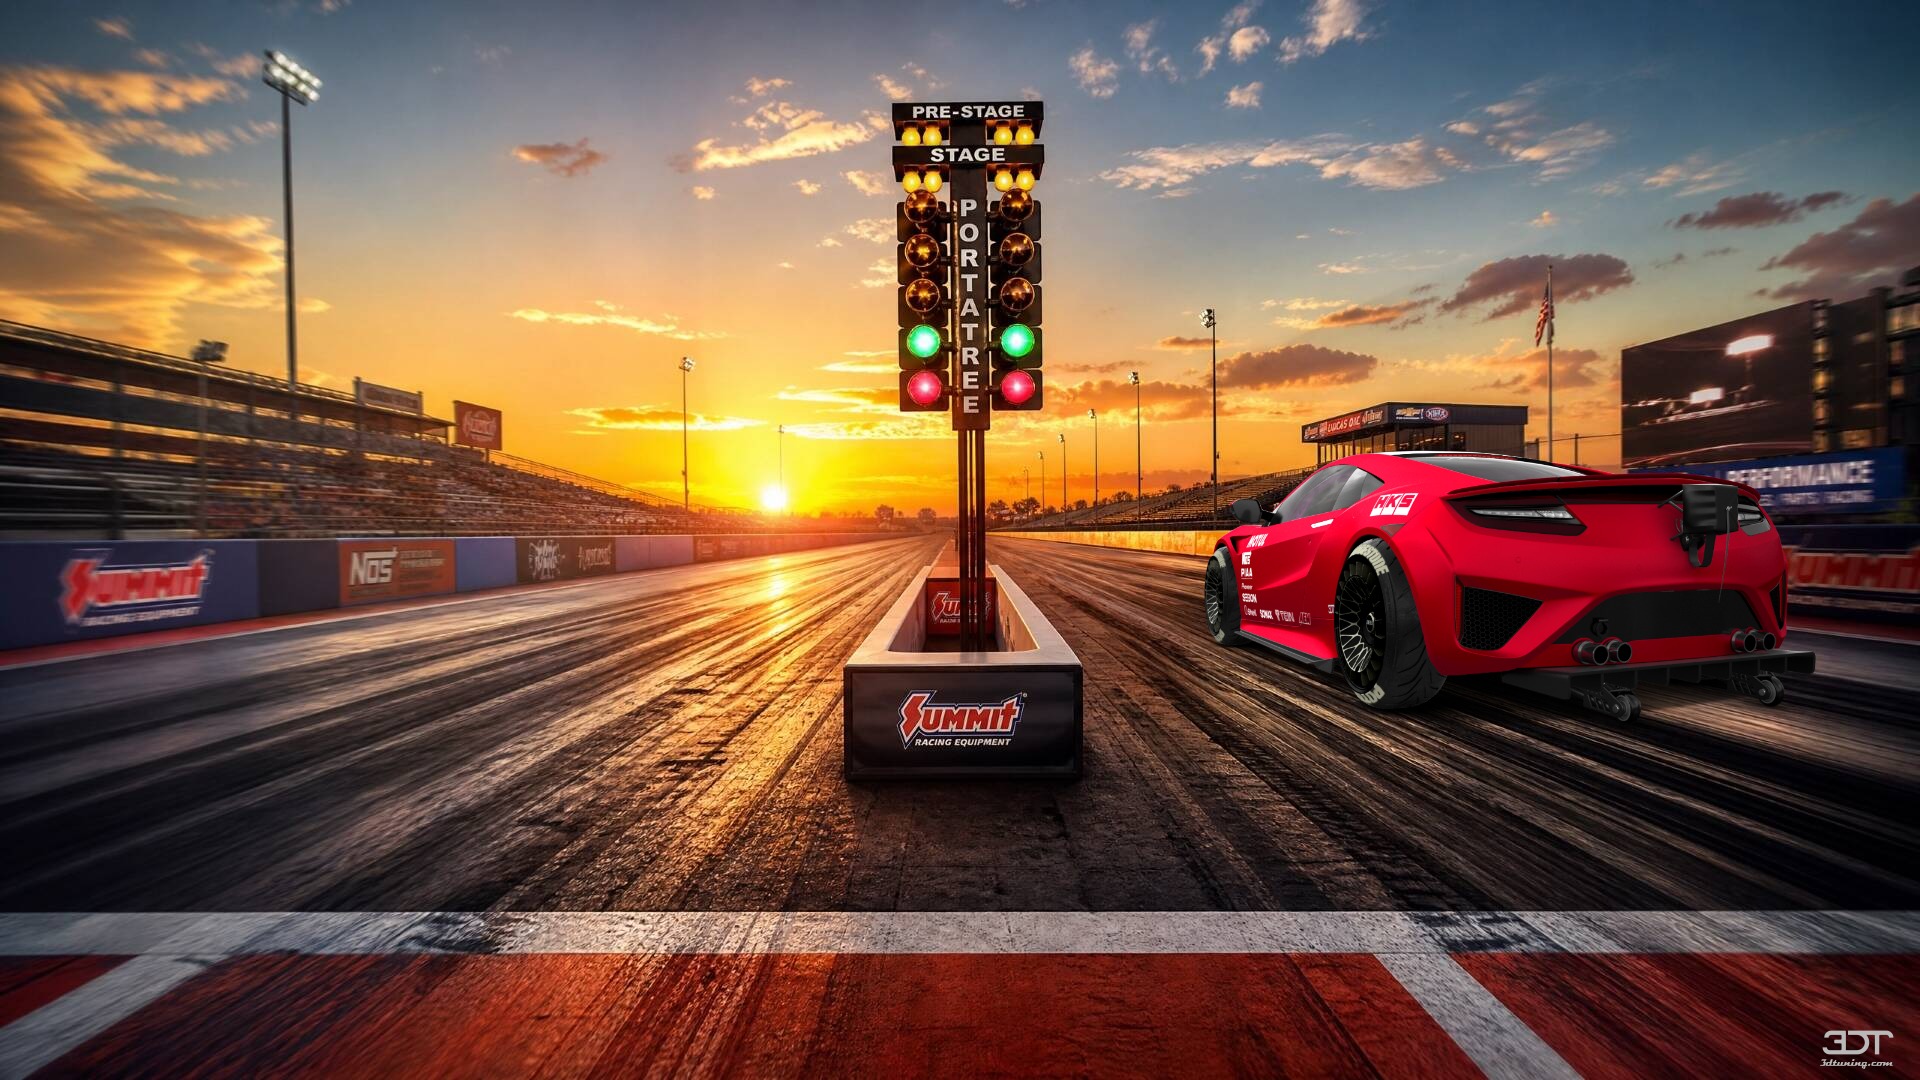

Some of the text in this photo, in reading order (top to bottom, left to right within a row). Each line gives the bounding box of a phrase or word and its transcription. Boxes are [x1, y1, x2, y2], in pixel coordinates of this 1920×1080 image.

[912, 104, 1025, 119] PRE-STAGE
[930, 147, 1006, 162] STAGE
[959, 199, 980, 414] PORTATREE
[1371, 493, 1418, 513] HKS
[350, 546, 398, 586] NOS
[914, 738, 1012, 748] RACING EQUIPMENT
